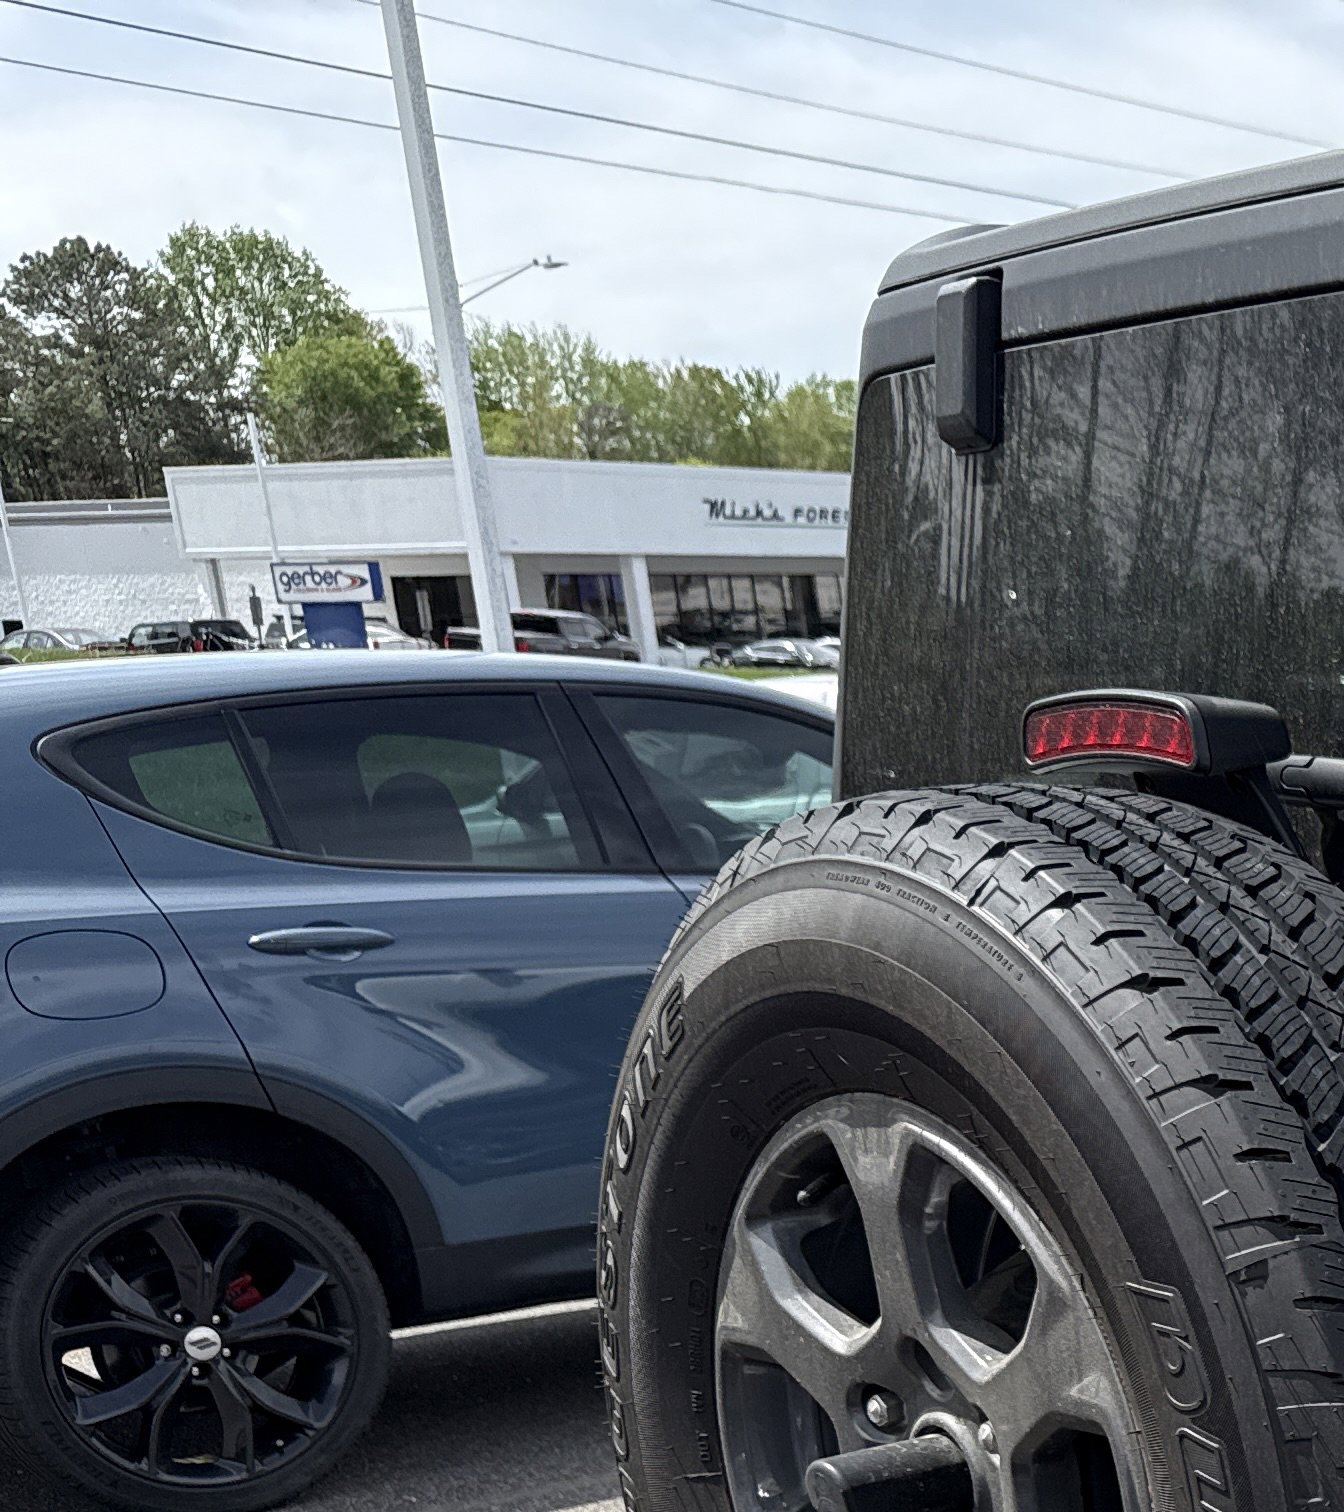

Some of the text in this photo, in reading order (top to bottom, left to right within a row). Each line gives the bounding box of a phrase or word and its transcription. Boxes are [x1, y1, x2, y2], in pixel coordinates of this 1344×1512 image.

[279, 564, 343, 593] gerber
[896, 888, 938, 914] TRACTION
[955, 921, 1015, 971] TEMPERATURE
